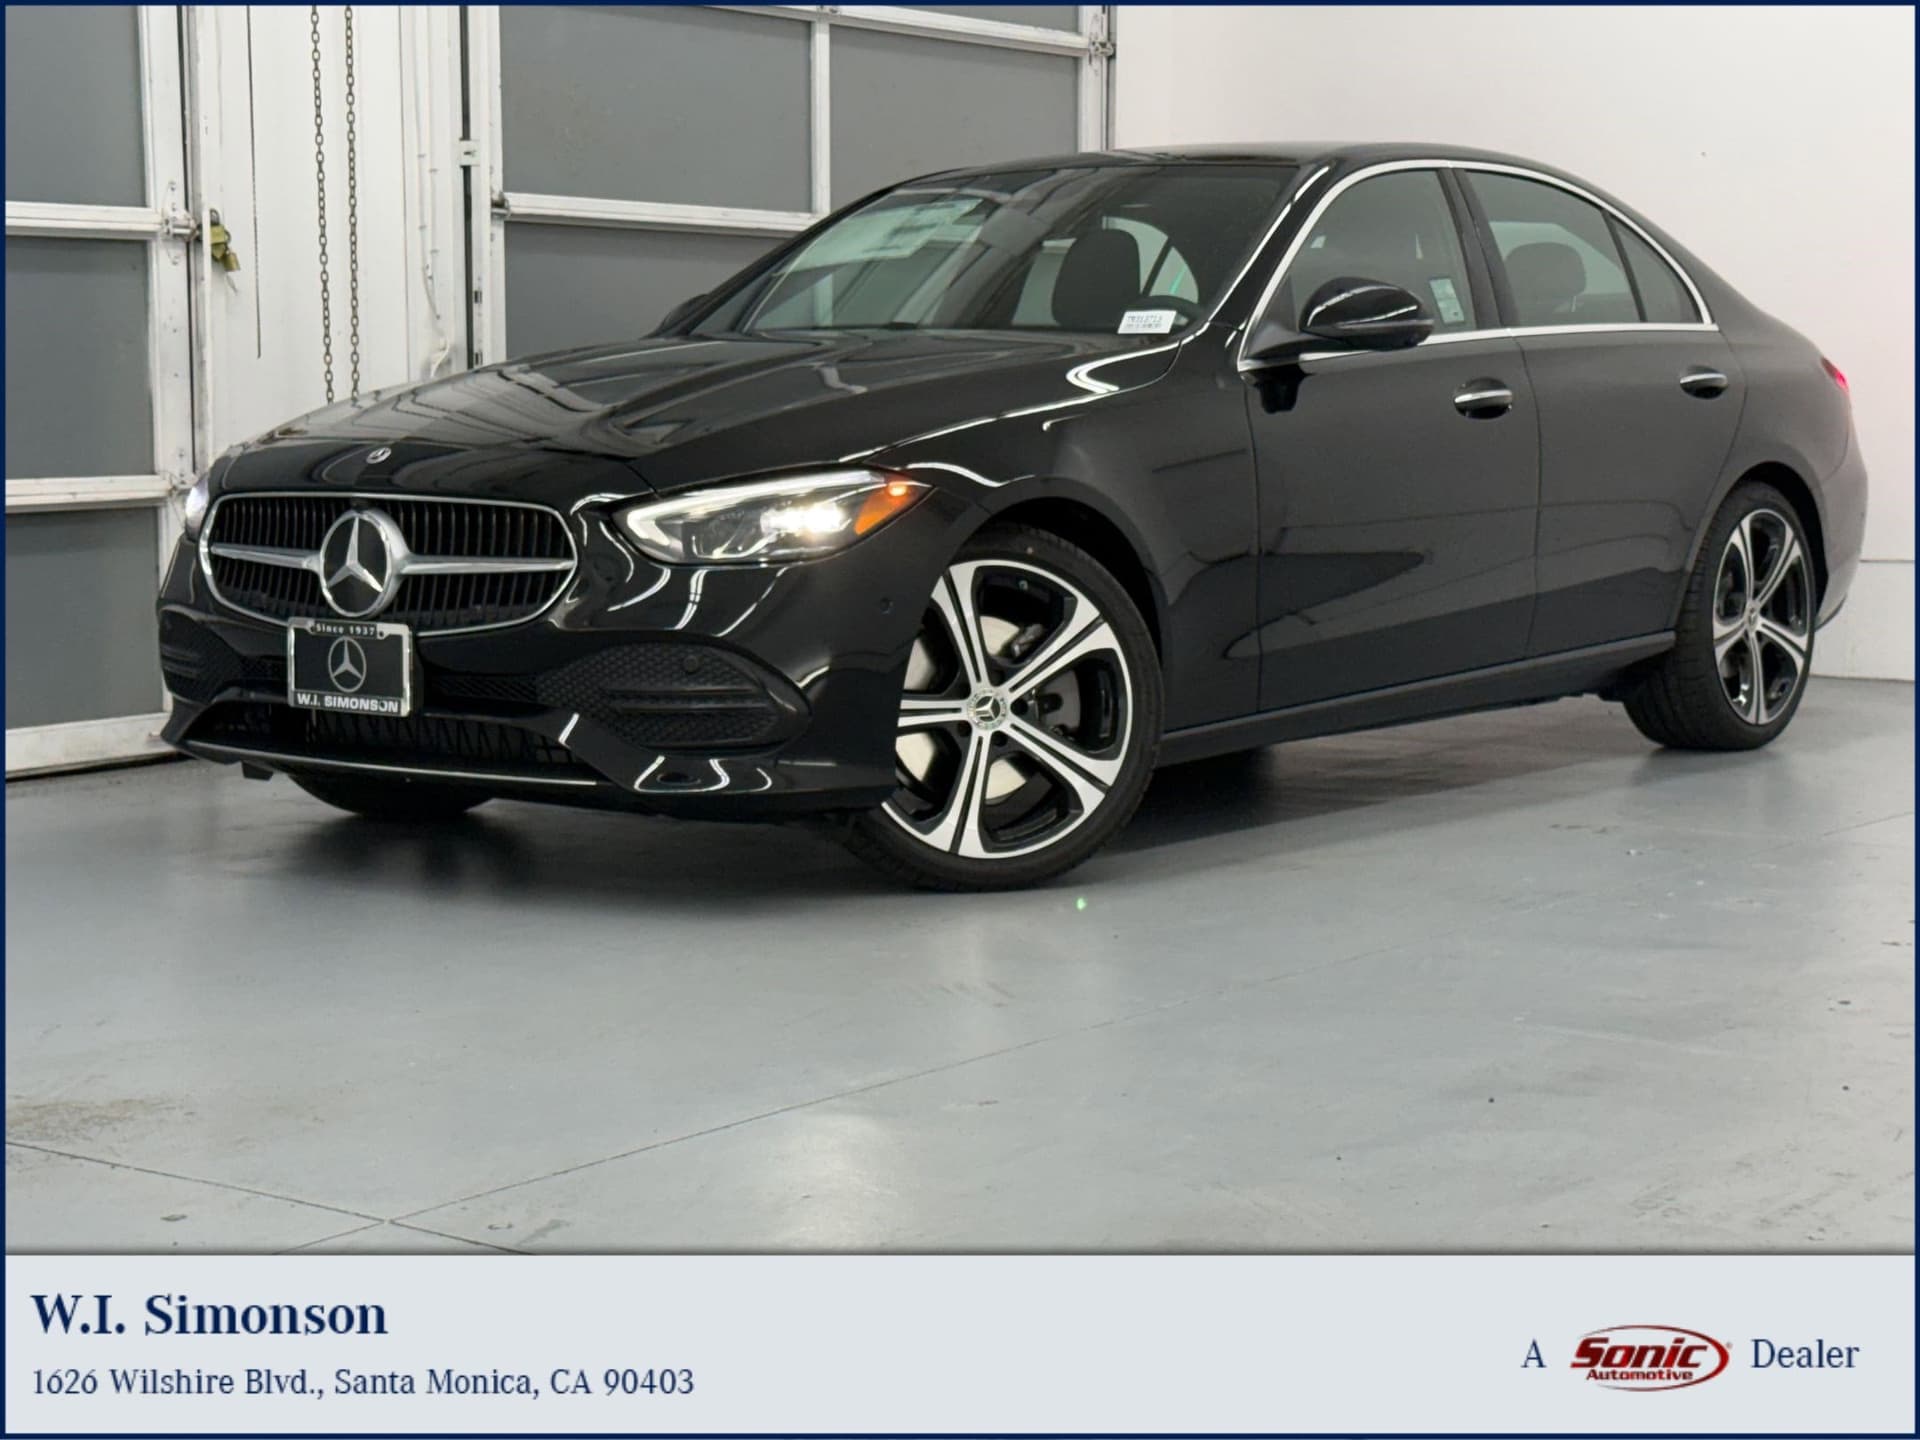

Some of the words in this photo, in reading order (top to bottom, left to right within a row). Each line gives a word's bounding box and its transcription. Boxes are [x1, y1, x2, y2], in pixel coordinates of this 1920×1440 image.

[315, 624, 344, 634] Since
[349, 626, 375, 635] 1937
[297, 693, 321, 706] W.I.
[324, 695, 399, 713] SIMONSON
